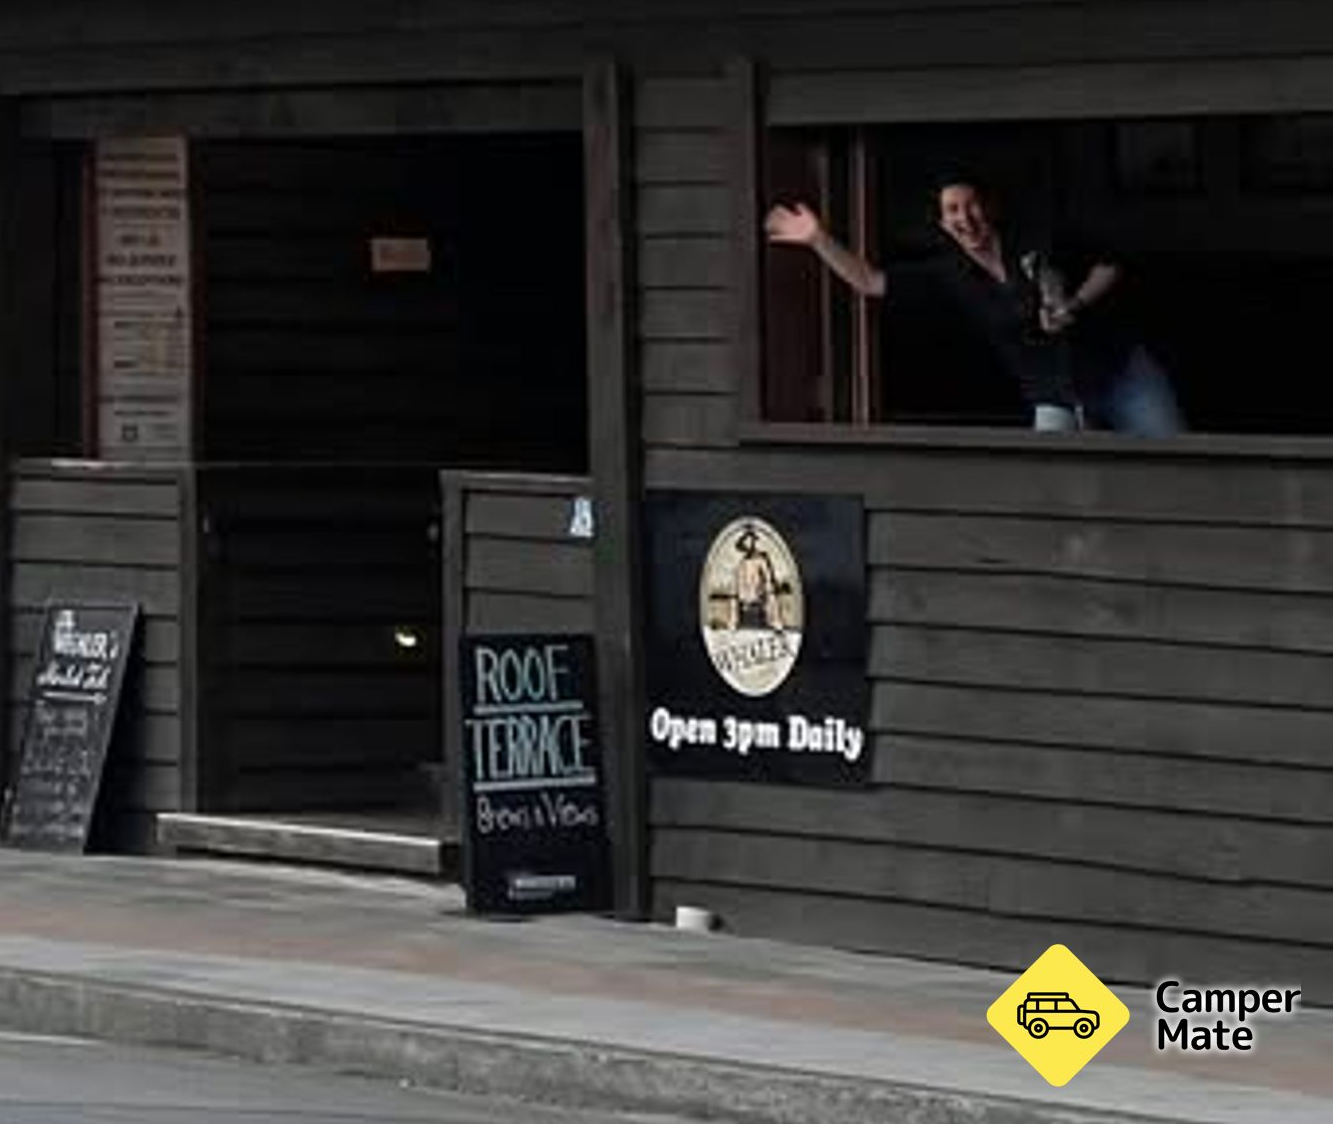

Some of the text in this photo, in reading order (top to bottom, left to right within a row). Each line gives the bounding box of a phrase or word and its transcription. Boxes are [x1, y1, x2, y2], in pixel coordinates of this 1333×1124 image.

[475, 644, 569, 703] ROOF
[465, 713, 592, 780] TERRACE
[651, 707, 862, 762] Open 3pm Daily
